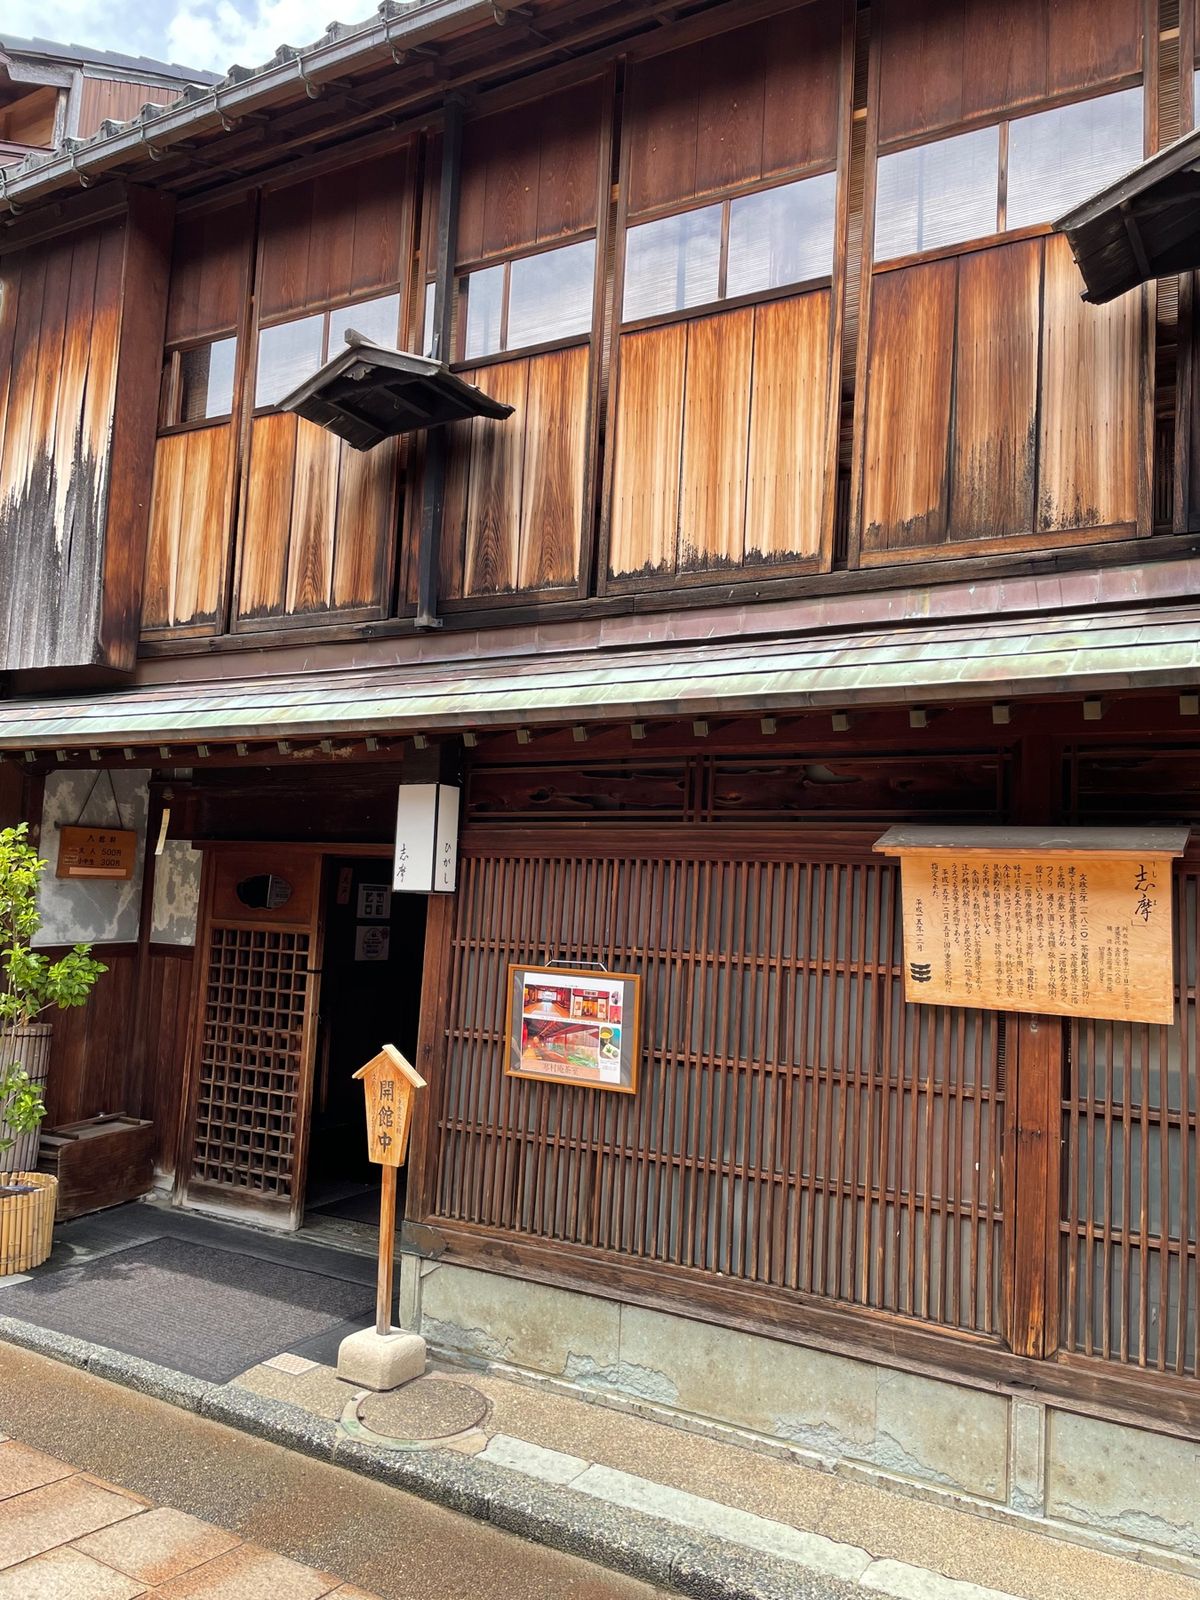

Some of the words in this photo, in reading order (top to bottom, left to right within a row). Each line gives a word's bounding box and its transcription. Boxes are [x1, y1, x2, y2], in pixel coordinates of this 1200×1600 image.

[443, 842, 452, 884] ひがし
[377, 1079, 395, 1154] 開館中
